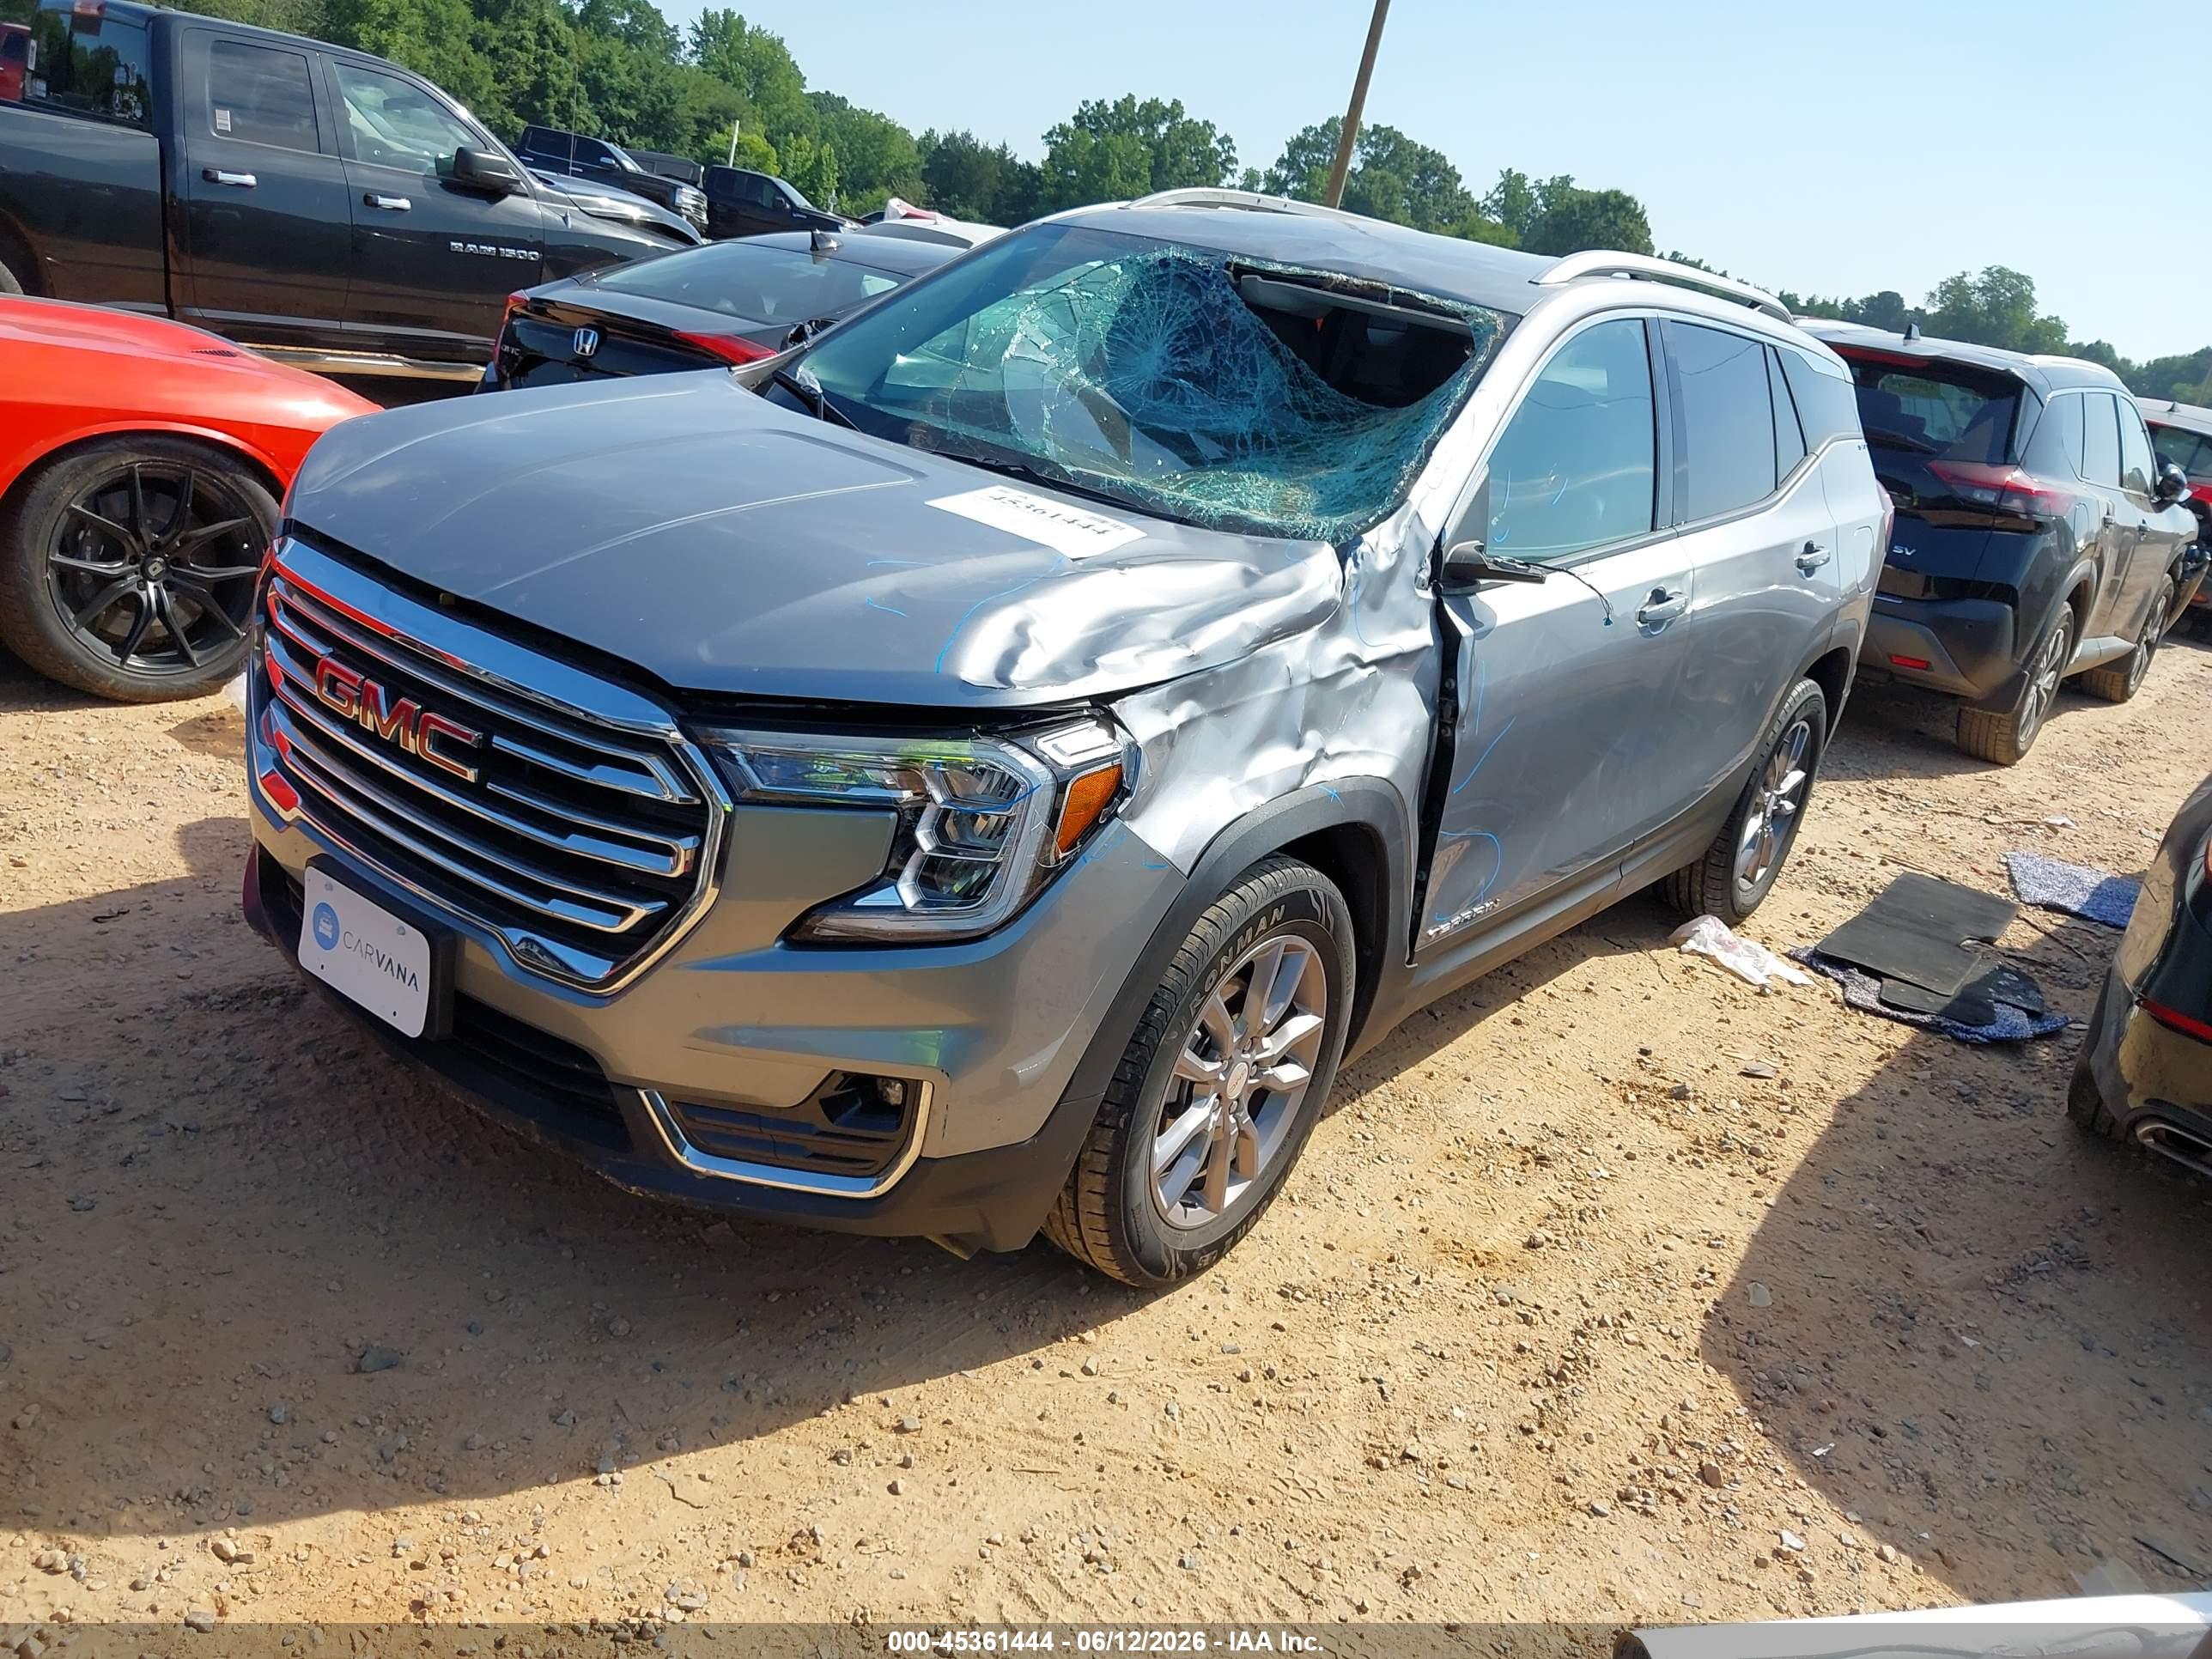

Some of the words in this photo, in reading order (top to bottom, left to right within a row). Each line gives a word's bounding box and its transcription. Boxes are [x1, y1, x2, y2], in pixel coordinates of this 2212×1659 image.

[449, 240, 496, 257] RAM
[498, 246, 541, 262] 1500
[988, 495, 1111, 536] 45361444
[1892, 544, 1917, 556] SV
[315, 656, 483, 783] GMC
[343, 931, 419, 993] CARVANA
[1181, 903, 1286, 1032] IRONMAN
